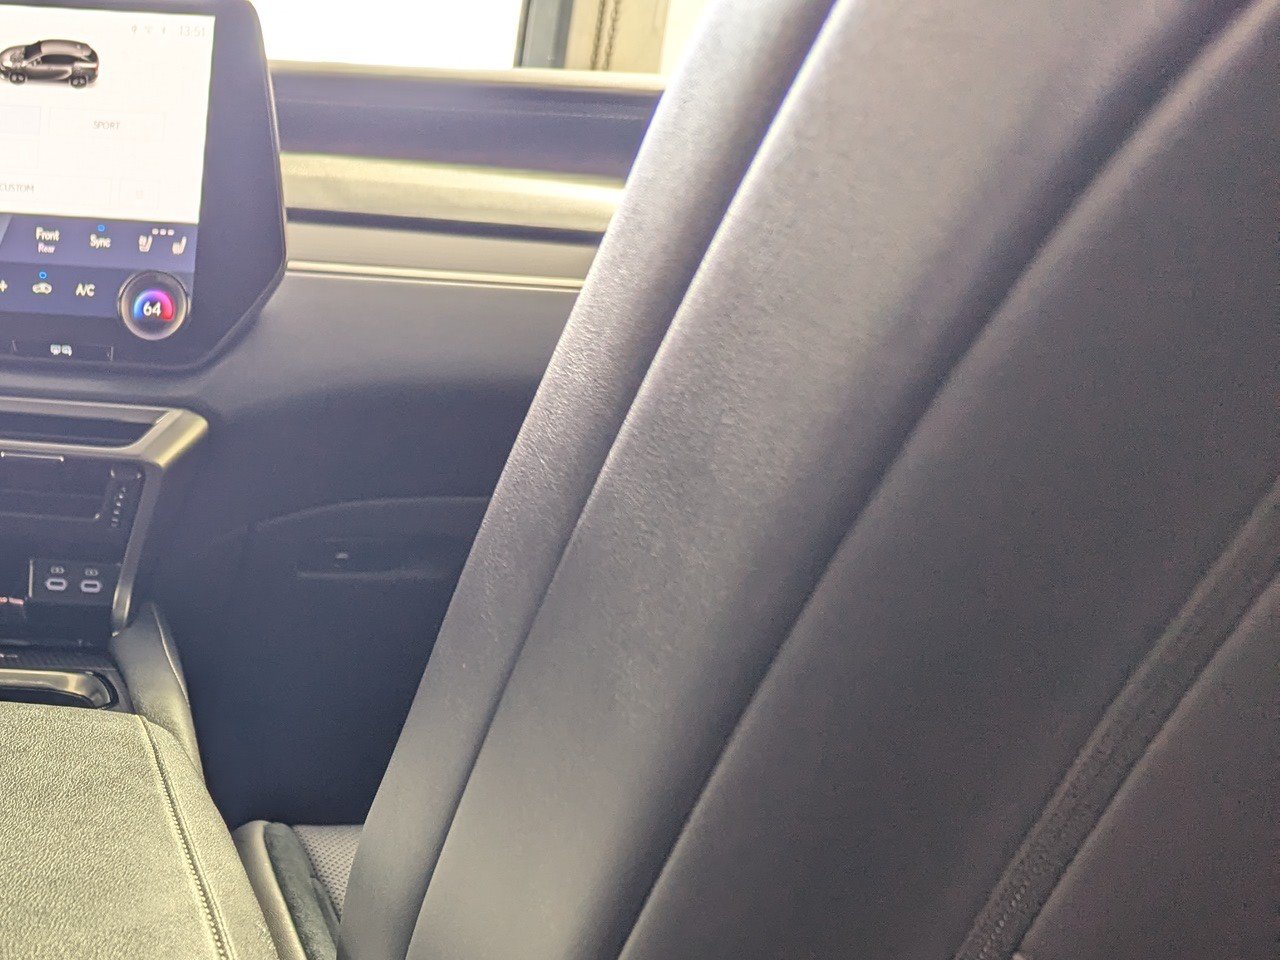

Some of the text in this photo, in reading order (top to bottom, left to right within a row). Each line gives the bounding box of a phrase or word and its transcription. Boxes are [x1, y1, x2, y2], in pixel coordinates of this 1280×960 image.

[93, 120, 120, 130] SPORT
[35, 226, 60, 242] Front
[89, 233, 111, 249] Sync
[38, 243, 56, 254] Rear
[75, 283, 96, 298] A/C
[143, 301, 162, 317] 64
